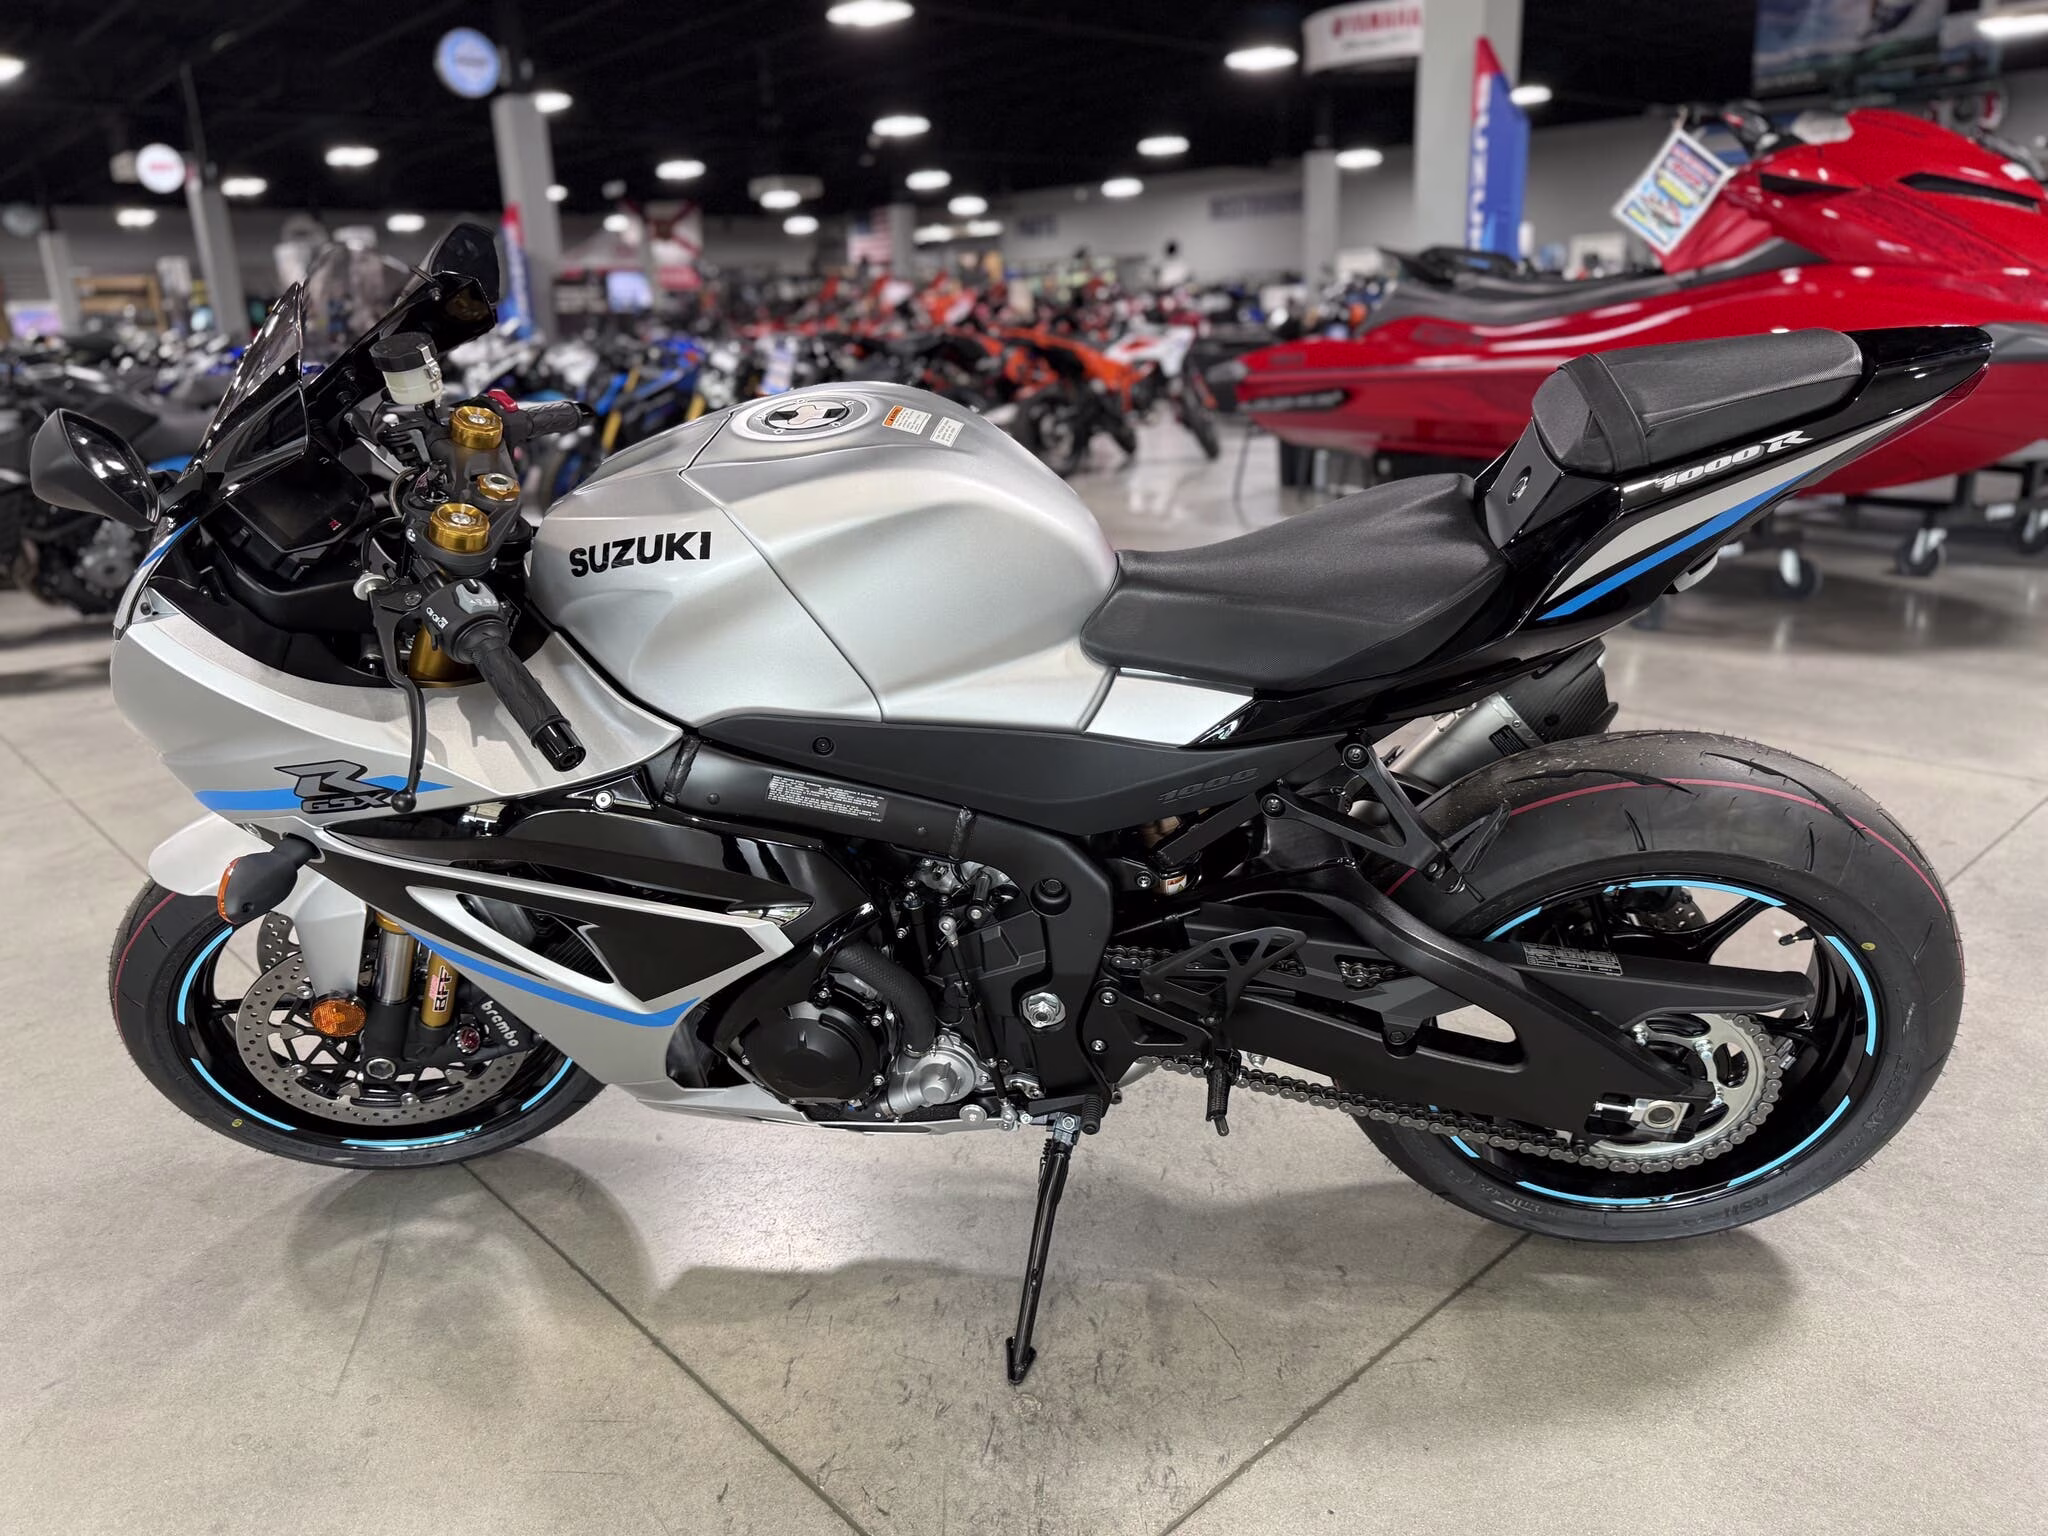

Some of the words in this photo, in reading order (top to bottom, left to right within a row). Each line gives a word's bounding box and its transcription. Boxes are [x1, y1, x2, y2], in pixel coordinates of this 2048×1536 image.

[569, 531, 711, 577] SUZUKI
[274, 759, 398, 799] R
[1157, 768, 1259, 804] 1000
[301, 792, 392, 814] GSX
[433, 965, 452, 1012] BFF
[481, 1000, 519, 1047] brembo
